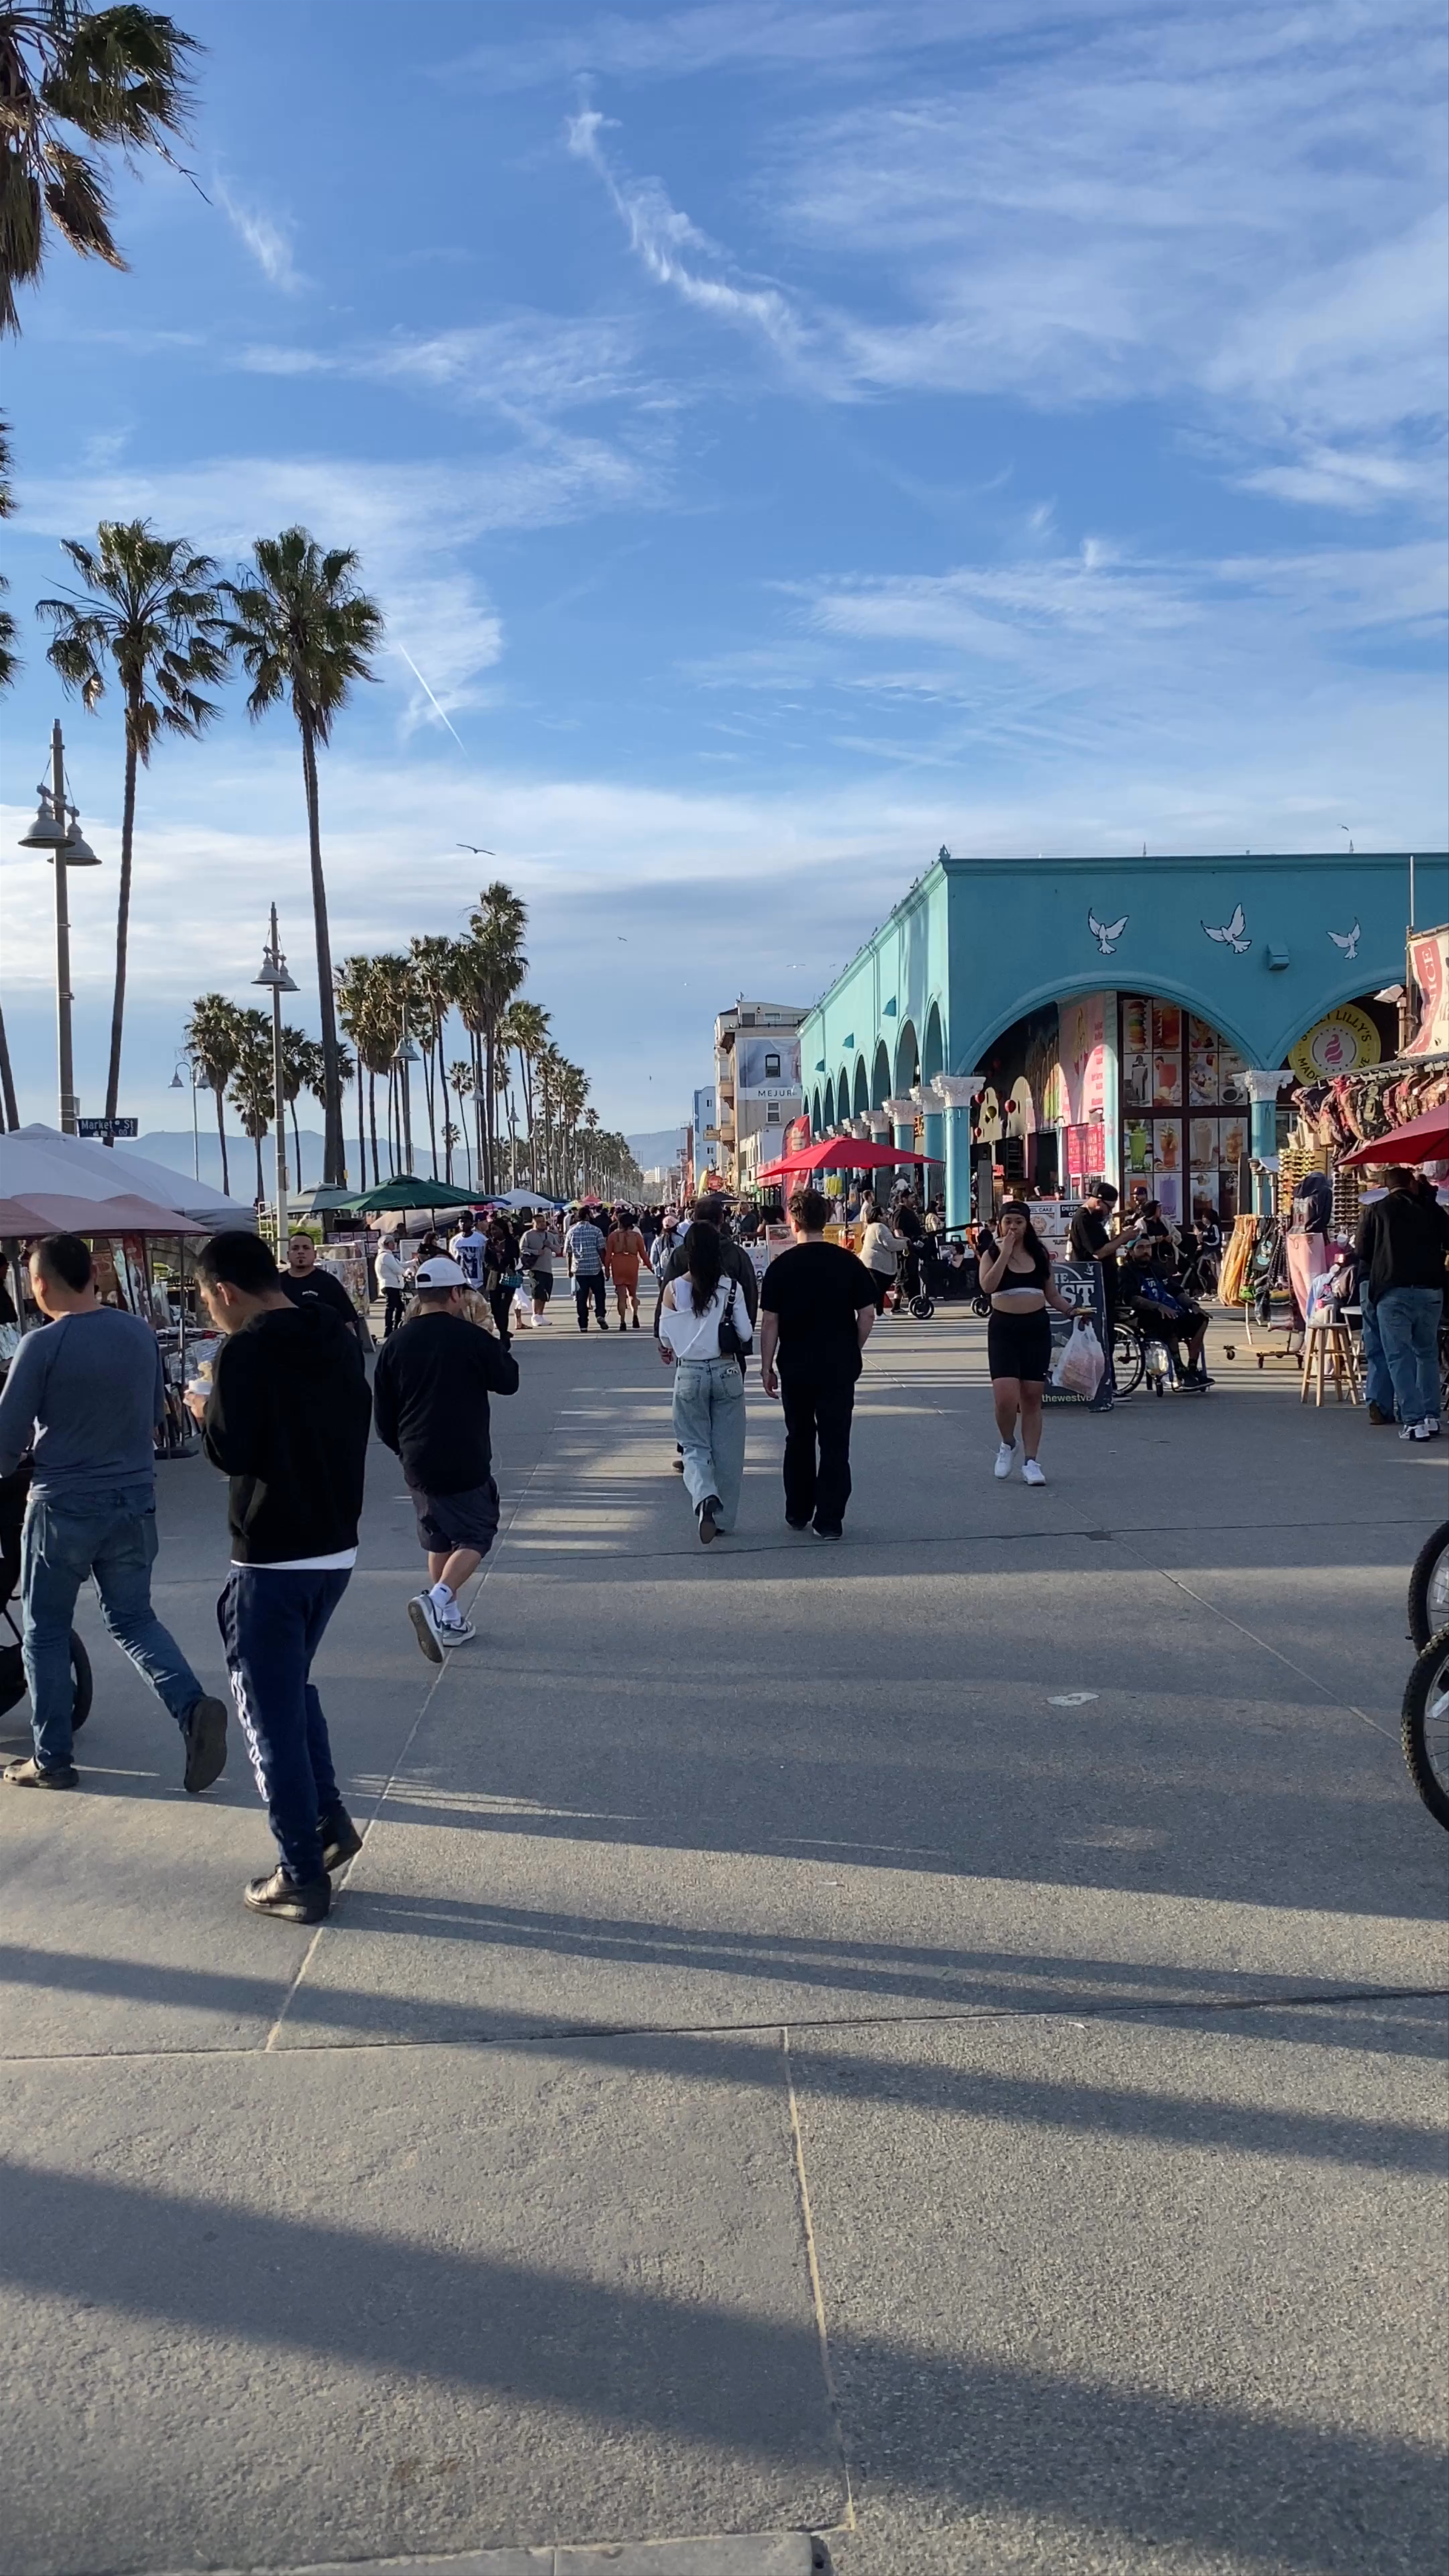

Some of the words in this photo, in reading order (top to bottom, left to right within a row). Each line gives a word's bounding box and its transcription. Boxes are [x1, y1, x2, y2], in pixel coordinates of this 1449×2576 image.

[1336, 1010, 1372, 1041] LILLY'S
[81, 1120, 112, 1130] Market
[124, 1119, 134, 1129] St
[1059, 1284, 1094, 1306] ST
